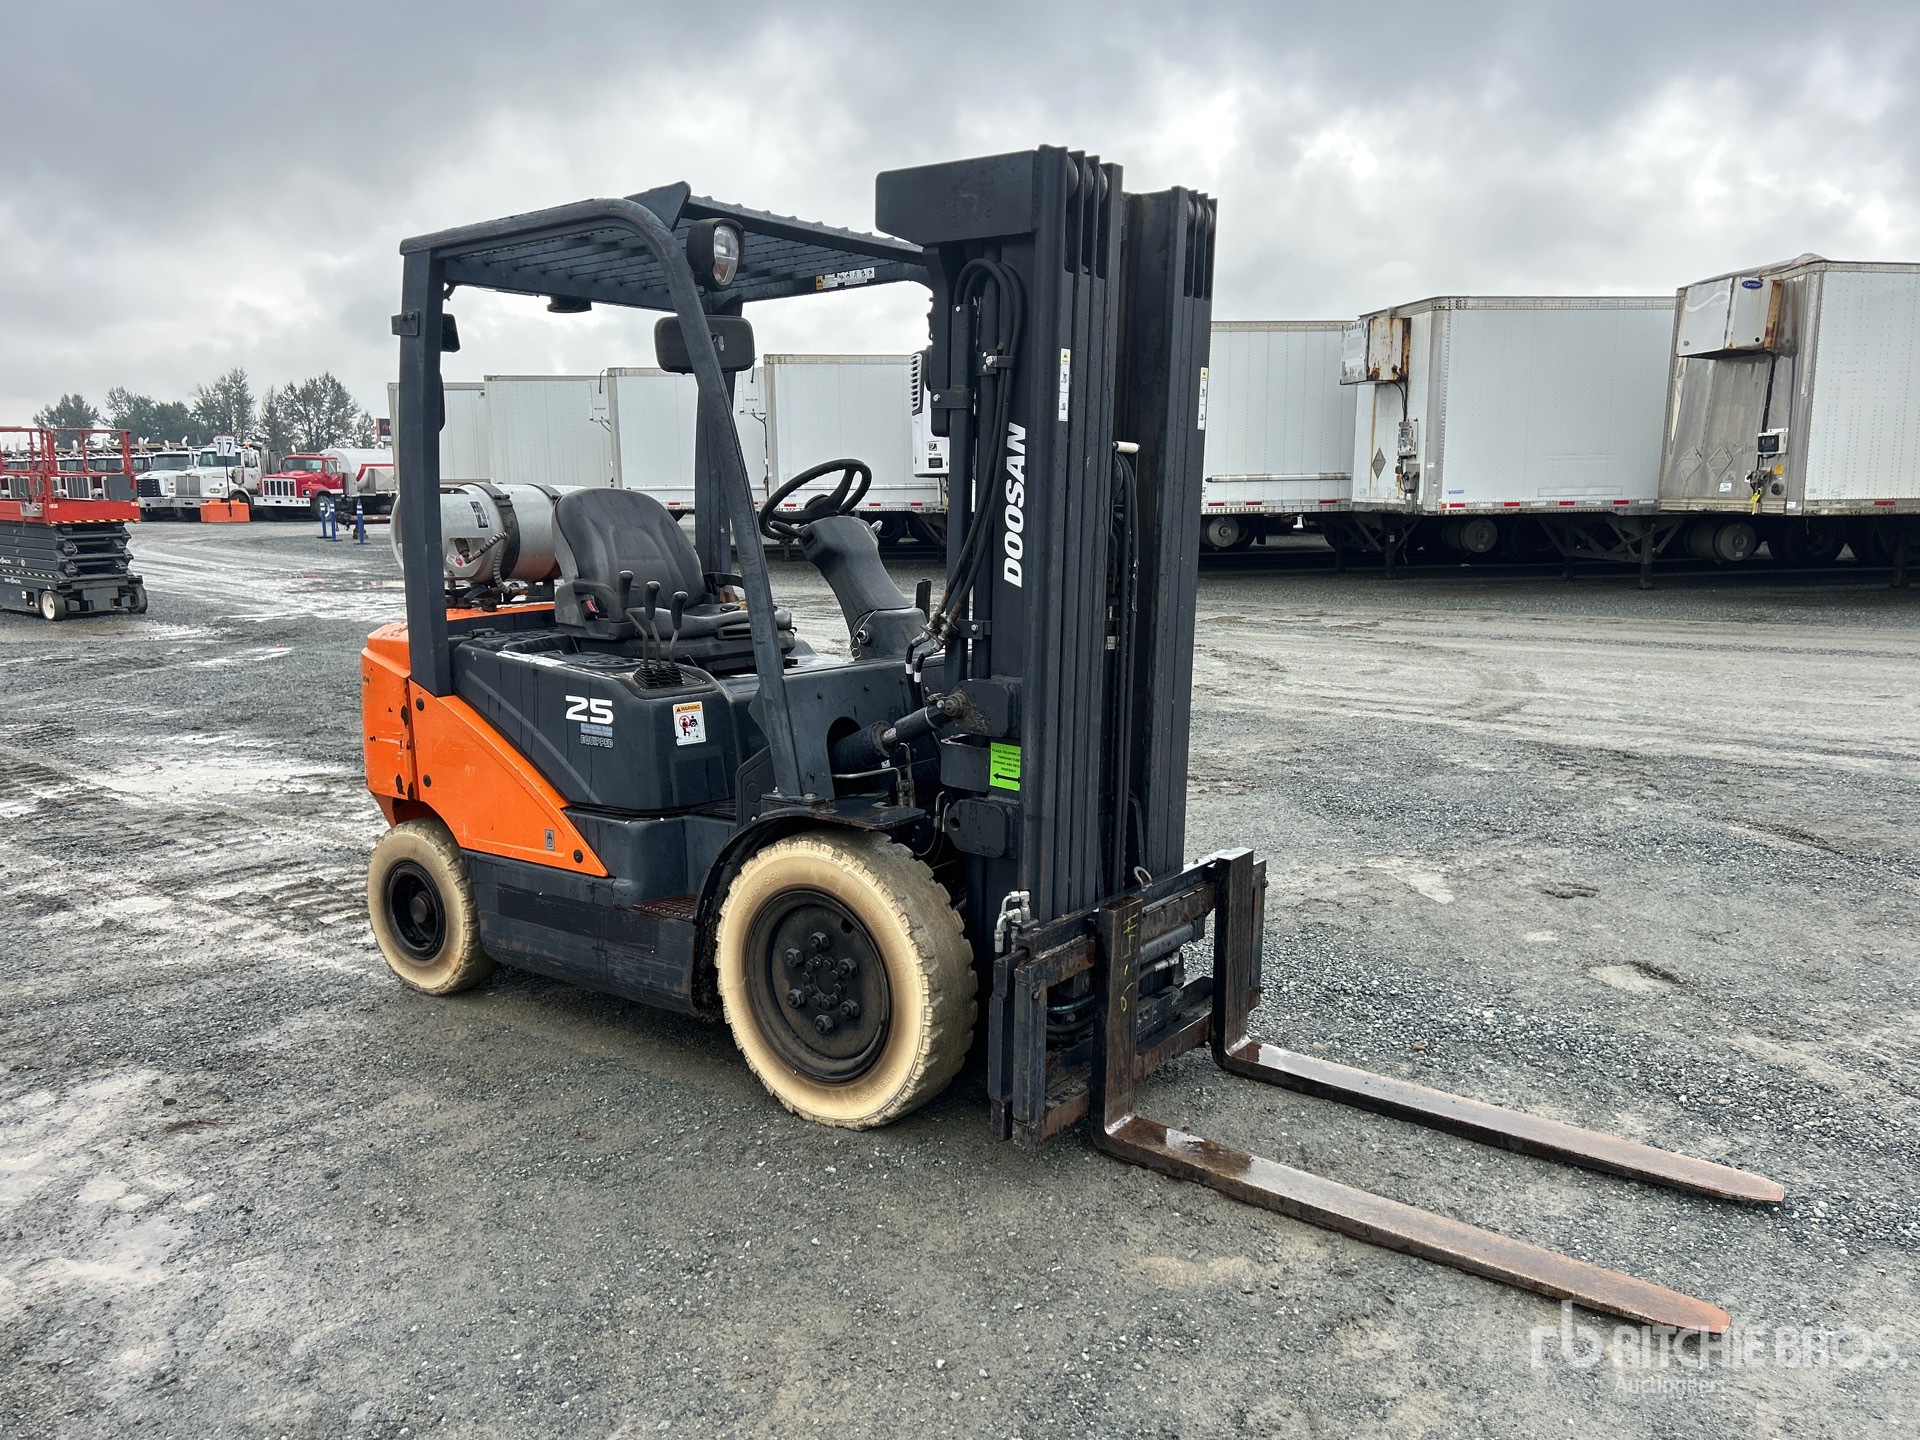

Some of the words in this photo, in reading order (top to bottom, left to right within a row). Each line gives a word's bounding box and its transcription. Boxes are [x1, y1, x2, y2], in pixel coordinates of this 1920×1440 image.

[226, 442, 232, 453] 7
[1004, 422, 1026, 588] DOOSAN
[565, 695, 614, 725] 25
[580, 734, 614, 749] EQUIPPED
[880, 1065, 897, 1088] MADE
[851, 1088, 875, 1104] KOREA
